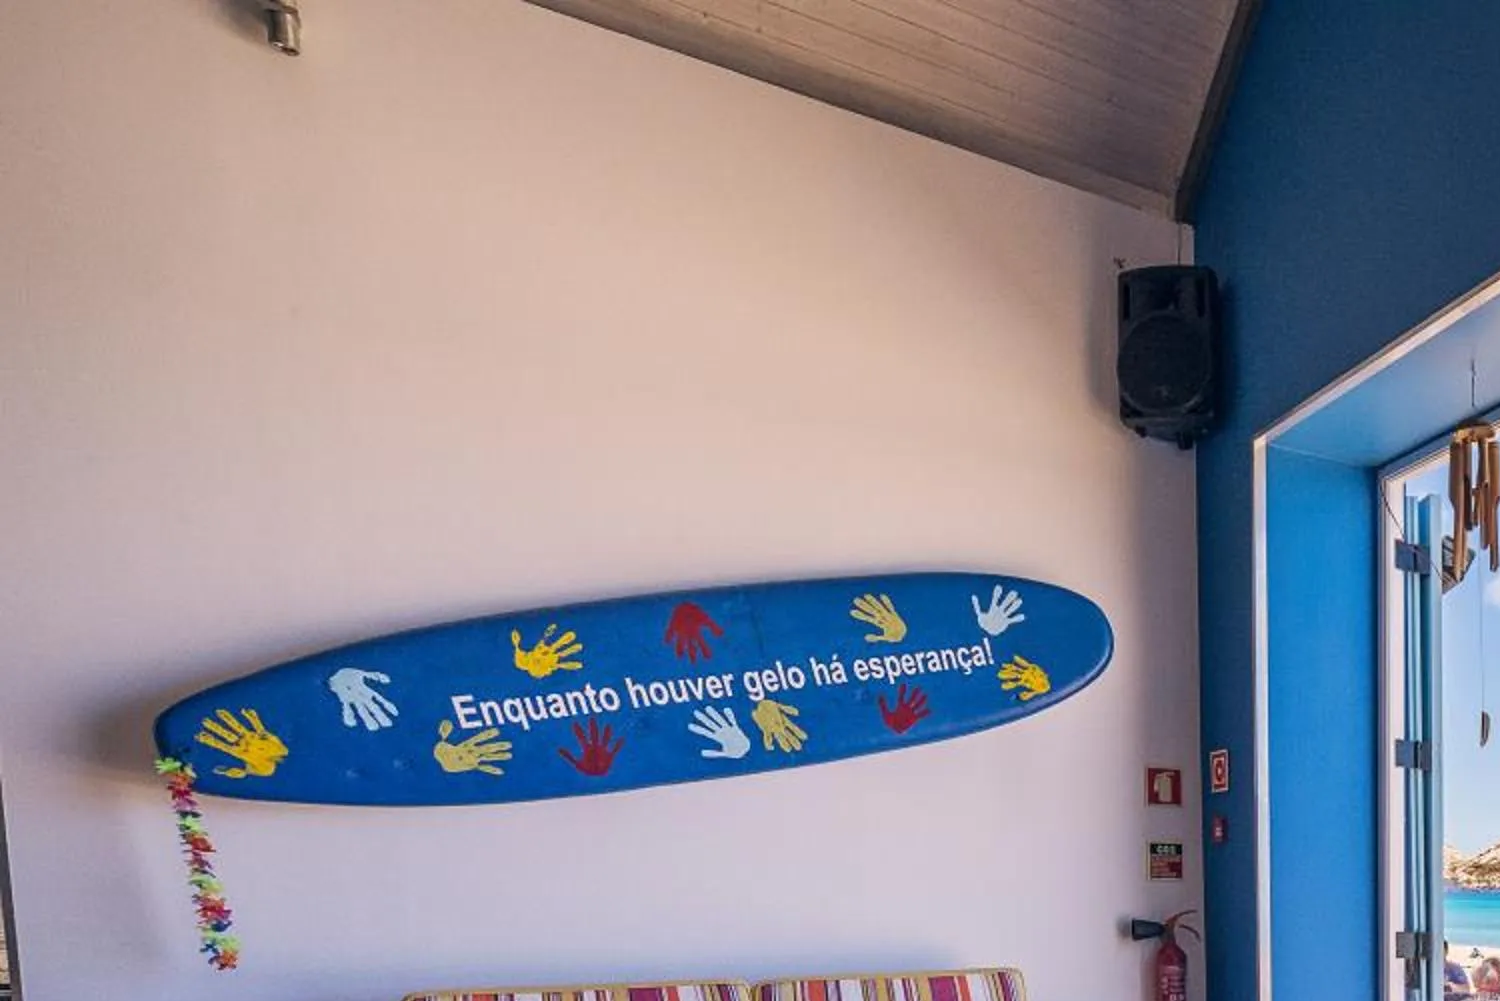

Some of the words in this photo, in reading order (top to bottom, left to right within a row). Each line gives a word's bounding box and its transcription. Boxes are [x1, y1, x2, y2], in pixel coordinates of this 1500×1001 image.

[451, 683, 622, 731] Enquanto
[624, 675, 734, 709] houver
[744, 662, 806, 702] gelo
[809, 653, 849, 686] há
[852, 637, 995, 685] esperança!
